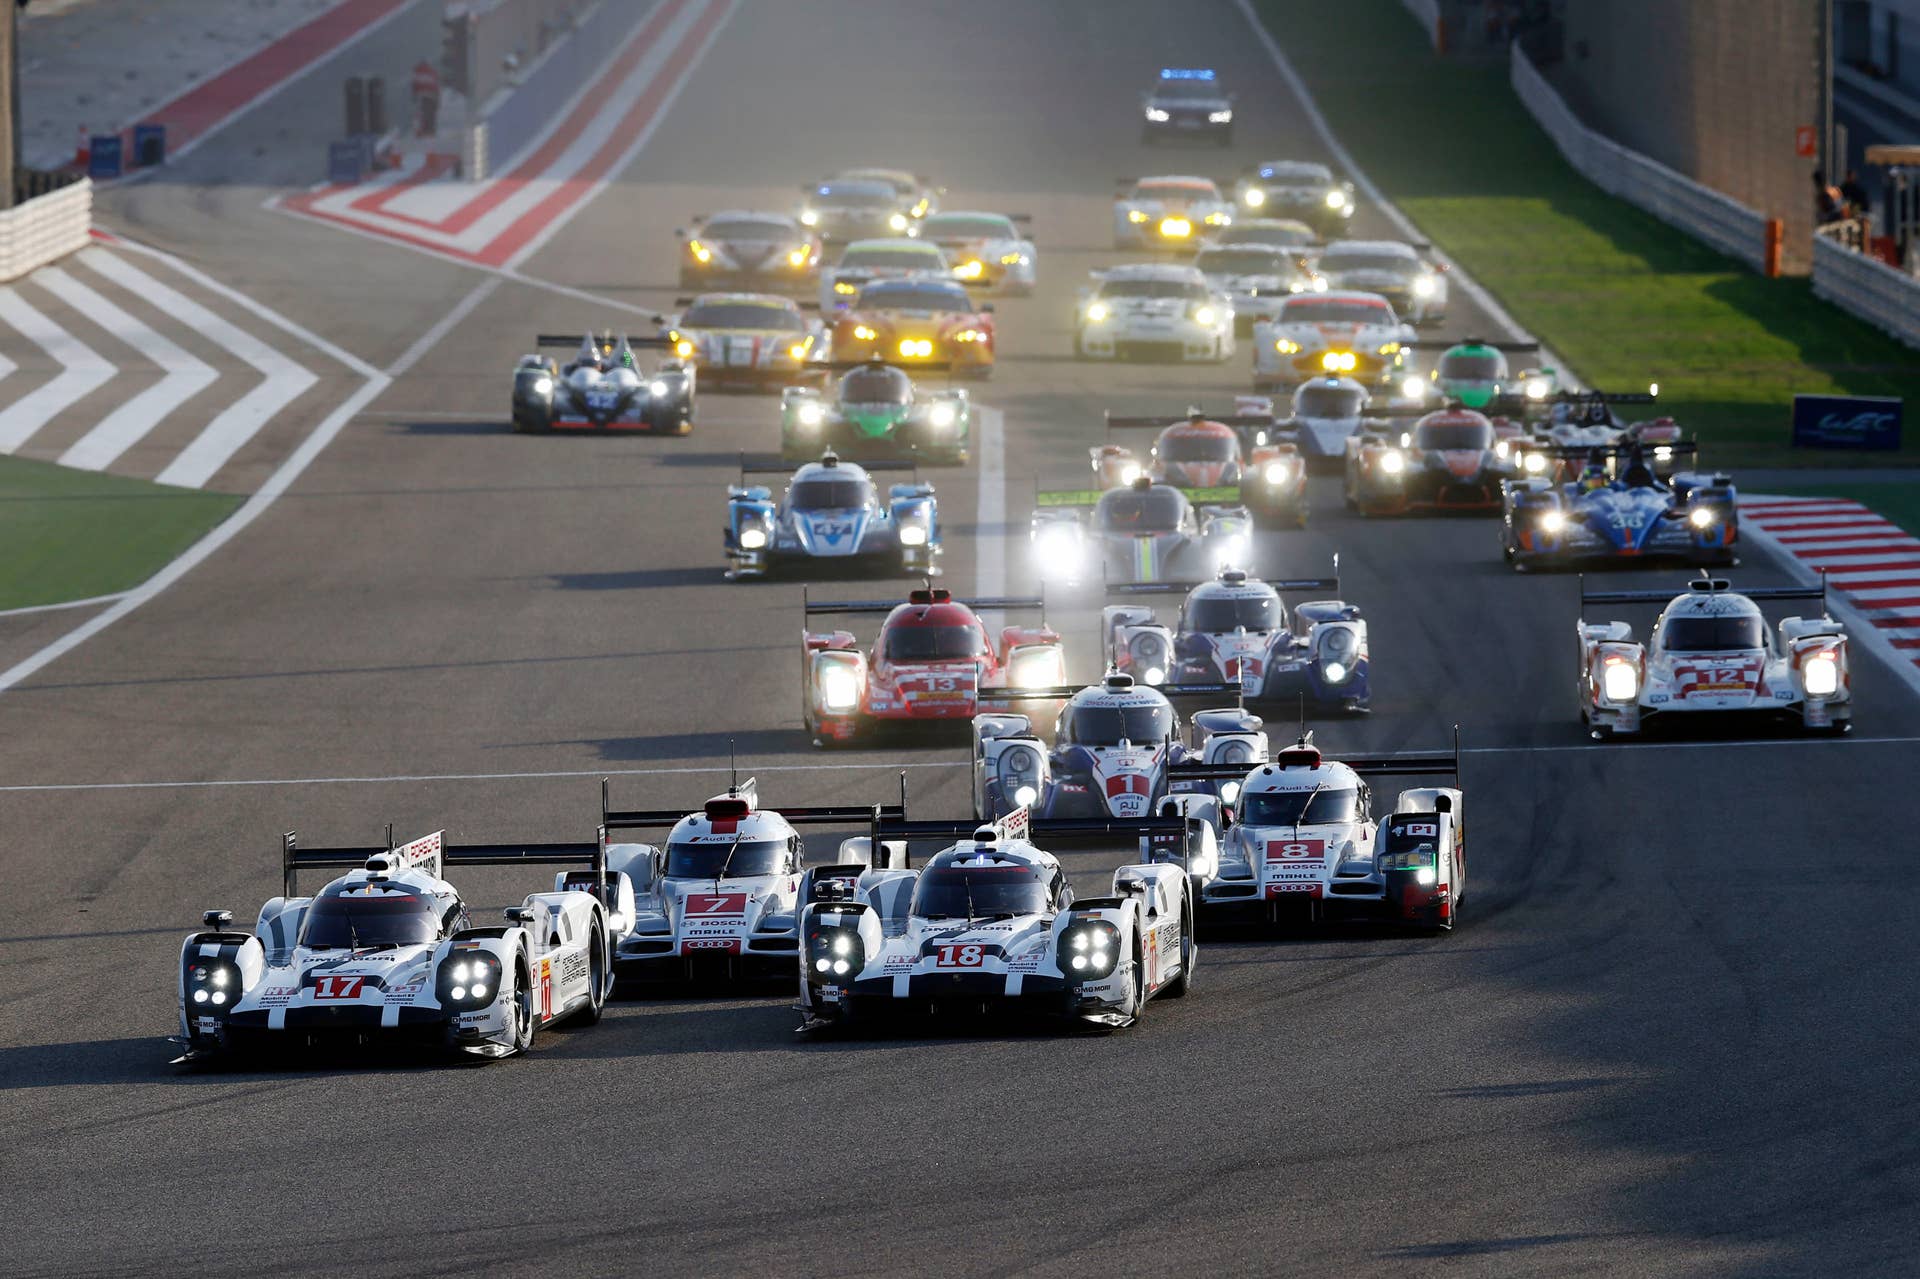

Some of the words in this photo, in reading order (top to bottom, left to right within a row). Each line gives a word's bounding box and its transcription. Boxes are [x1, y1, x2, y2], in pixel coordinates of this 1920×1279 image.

[1703, 669, 1738, 683] 12
[923, 678, 956, 691] 13
[1121, 775, 1134, 793] 1
[1304, 784, 1332, 792] Sport
[1411, 825, 1433, 834] P1
[410, 835, 440, 859] PORSCHE
[1281, 843, 1311, 858] 8
[704, 898, 730, 912] 7
[938, 946, 982, 966] 18
[317, 977, 361, 997] 17
[452, 1015, 472, 1024] DMG
[472, 1013, 491, 1022] MORI
